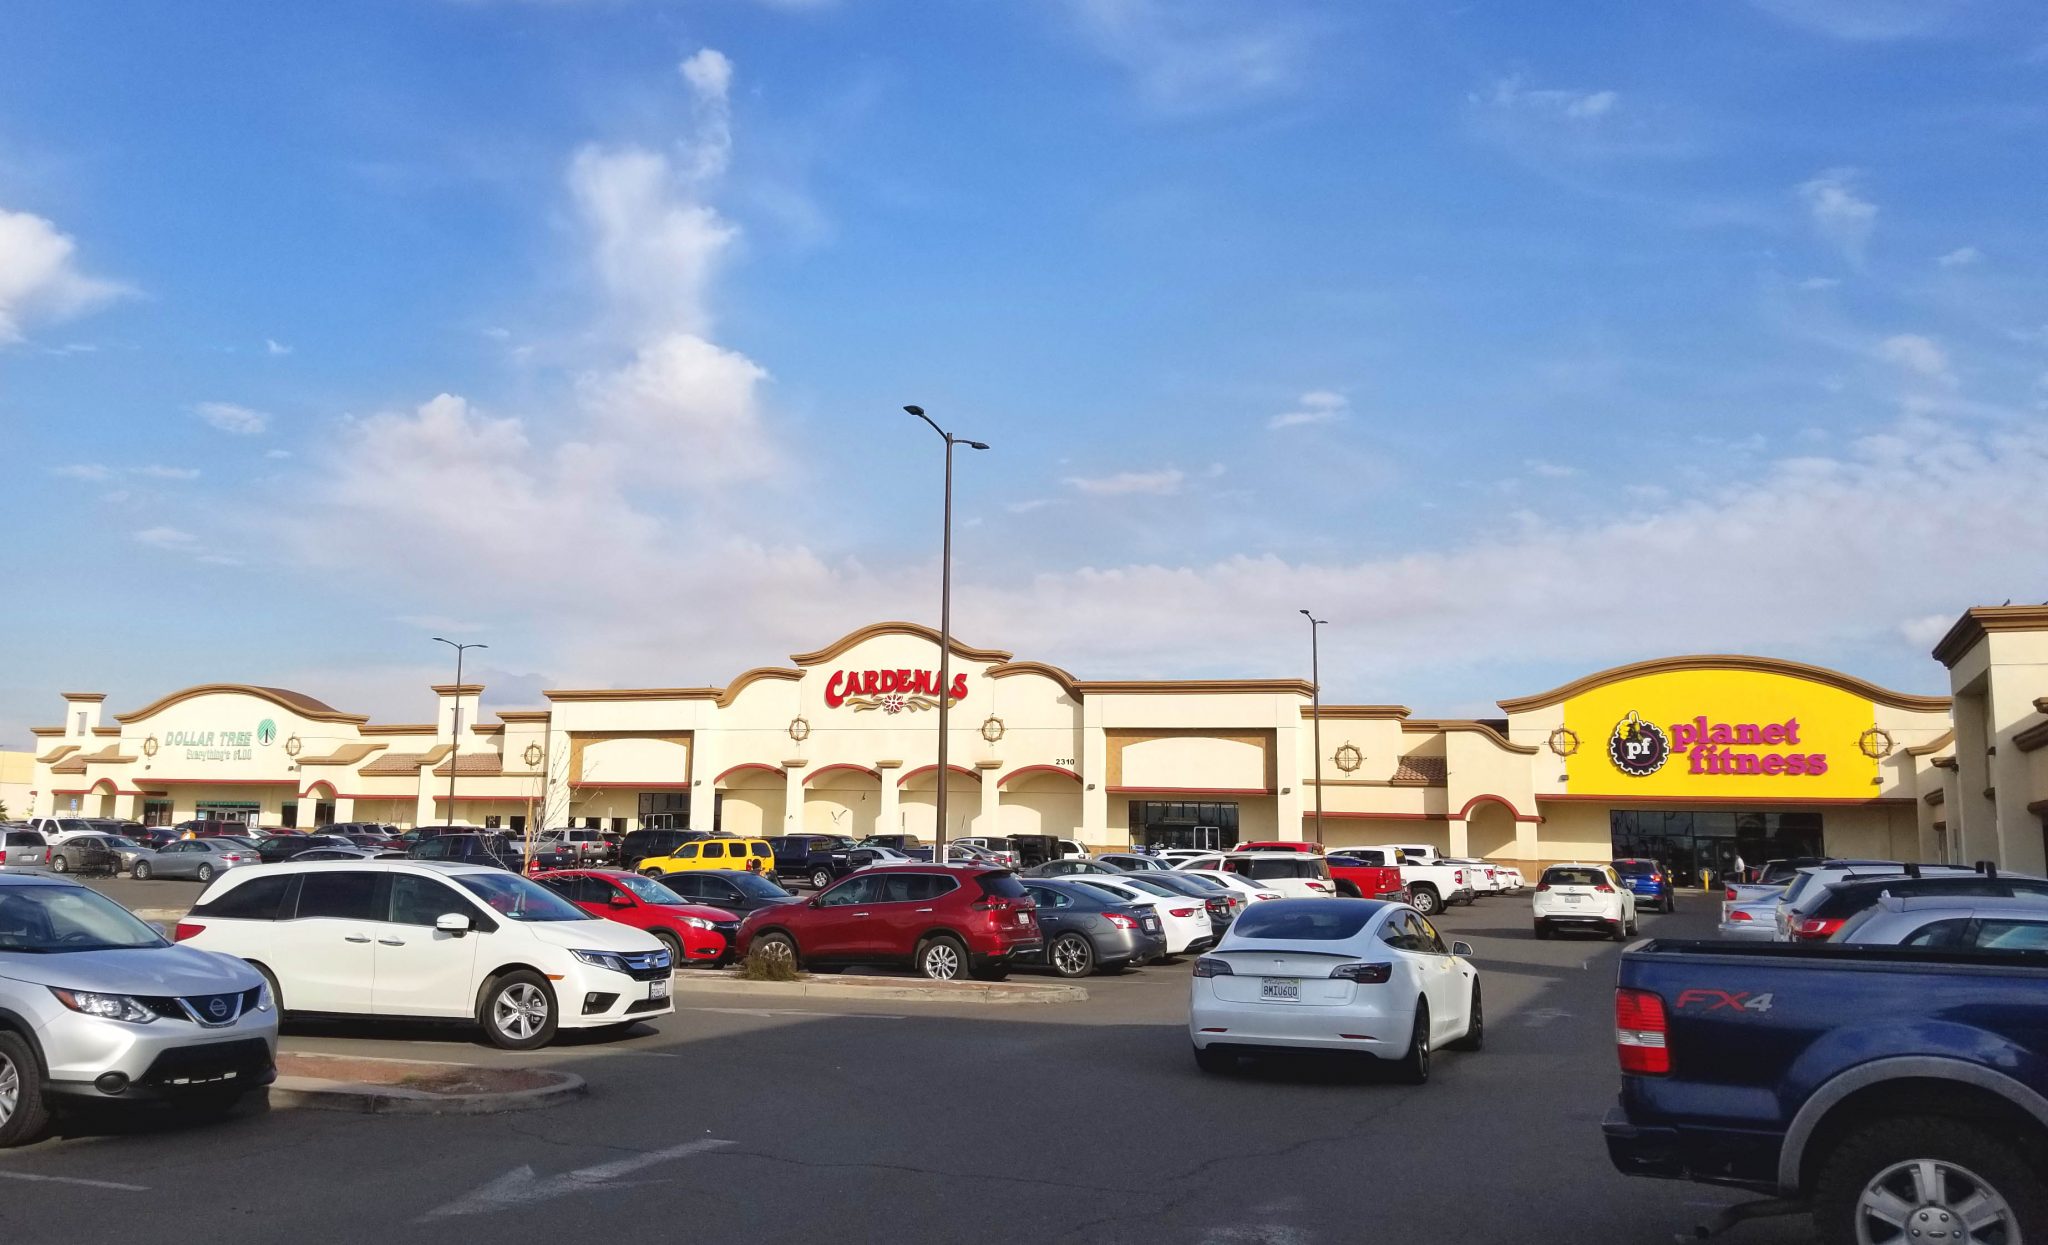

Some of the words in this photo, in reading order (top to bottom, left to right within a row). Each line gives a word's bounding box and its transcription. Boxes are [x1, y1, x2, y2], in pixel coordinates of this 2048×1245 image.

[165, 731, 215, 747] DOLLAR
[220, 731, 253, 747] TREE
[1671, 716, 1801, 753] planet
[1626, 736, 1652, 760] pf
[1689, 745, 1828, 776] fitness
[1676, 989, 1774, 1012] FX4
